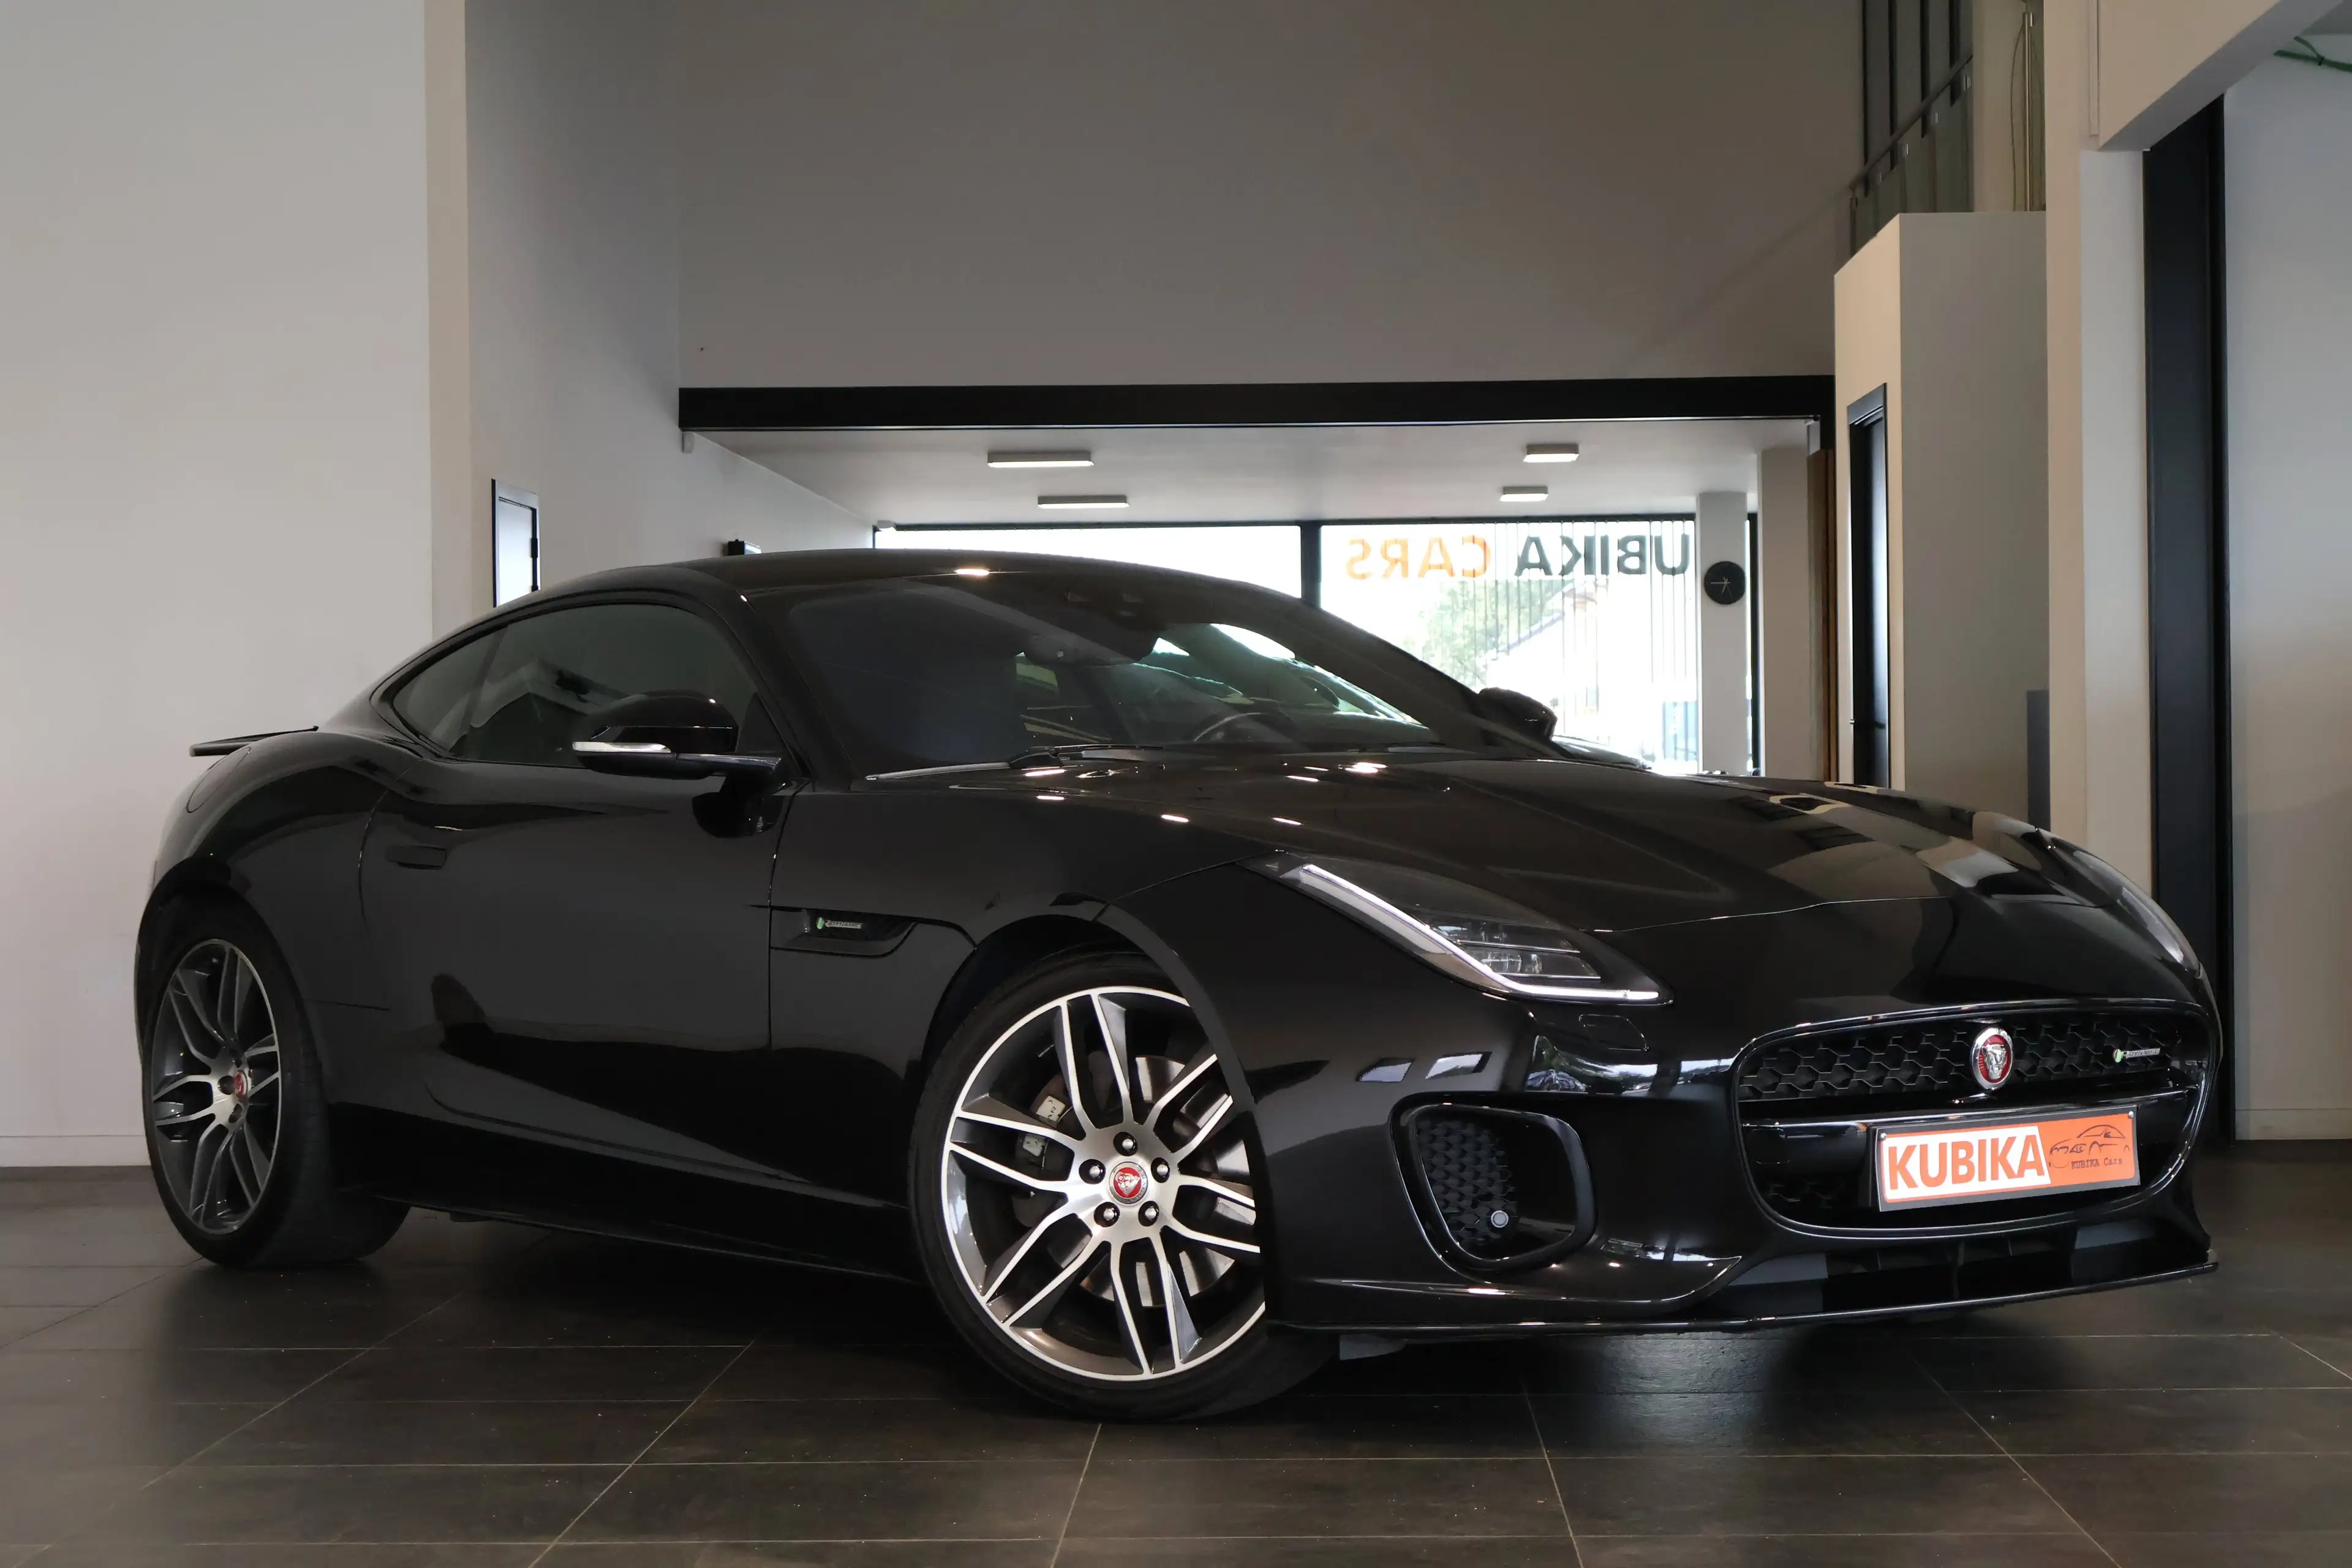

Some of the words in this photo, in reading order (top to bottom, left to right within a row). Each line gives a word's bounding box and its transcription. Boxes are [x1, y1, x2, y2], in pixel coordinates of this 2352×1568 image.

[1888, 1134, 2045, 1189] KUBIKA
[2071, 1159, 2100, 1169] KUBIKA
[2104, 1157, 2124, 1166] Cars
